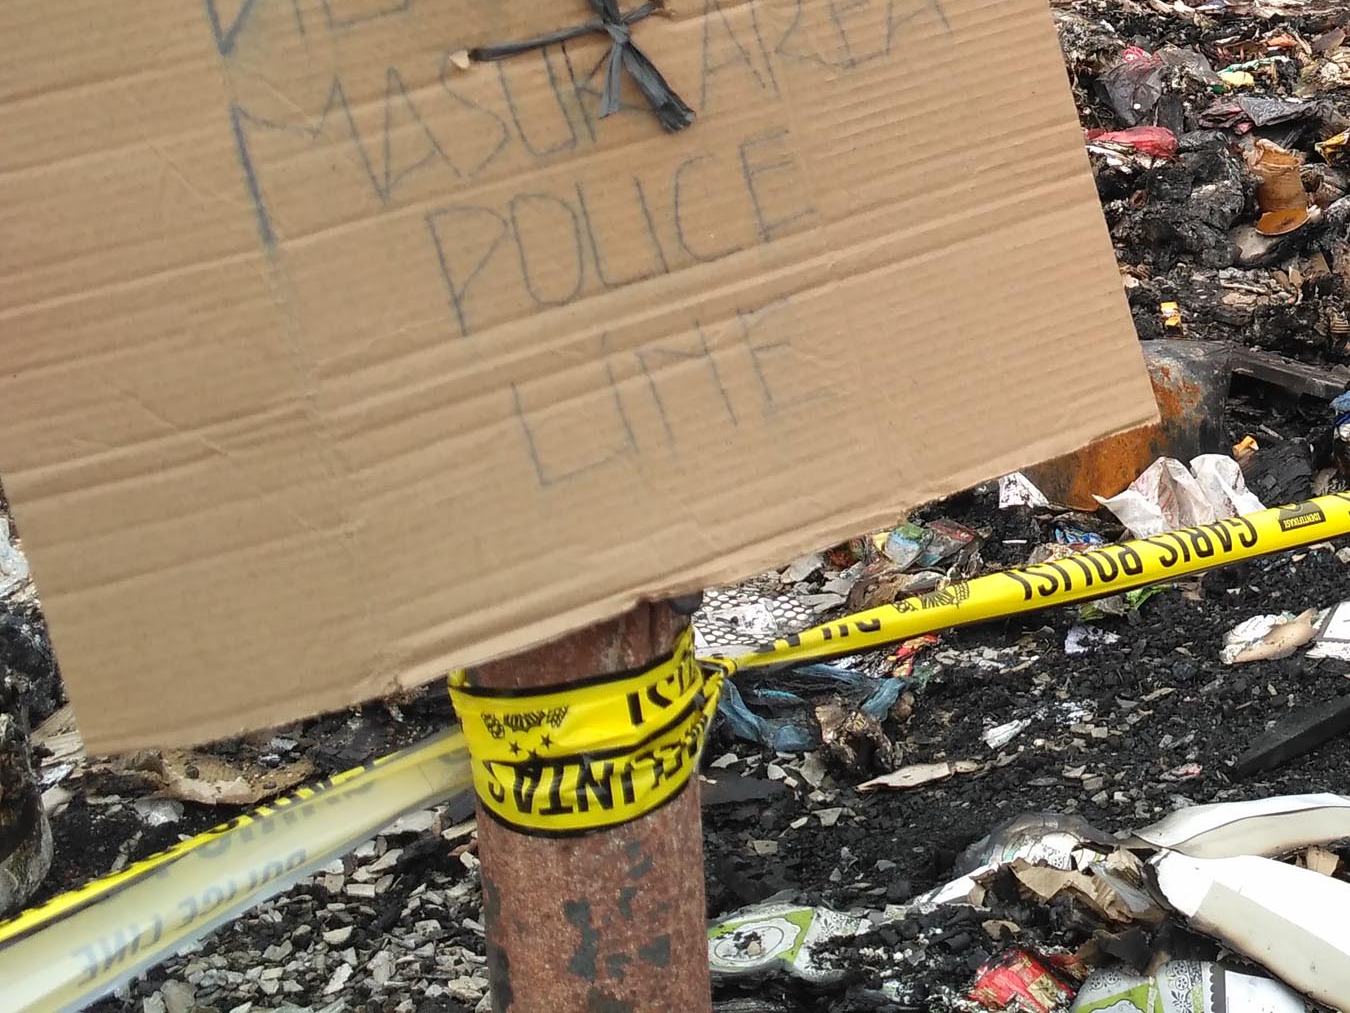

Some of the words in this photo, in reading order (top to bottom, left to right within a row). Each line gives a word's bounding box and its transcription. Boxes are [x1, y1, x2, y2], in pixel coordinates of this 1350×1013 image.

[426, 128, 815, 336] POLICE
[1146, 515, 1259, 568] GARIS
[1283, 512, 1322, 530] IDENTIFIKASI
[1003, 543, 1145, 601] POLISI
